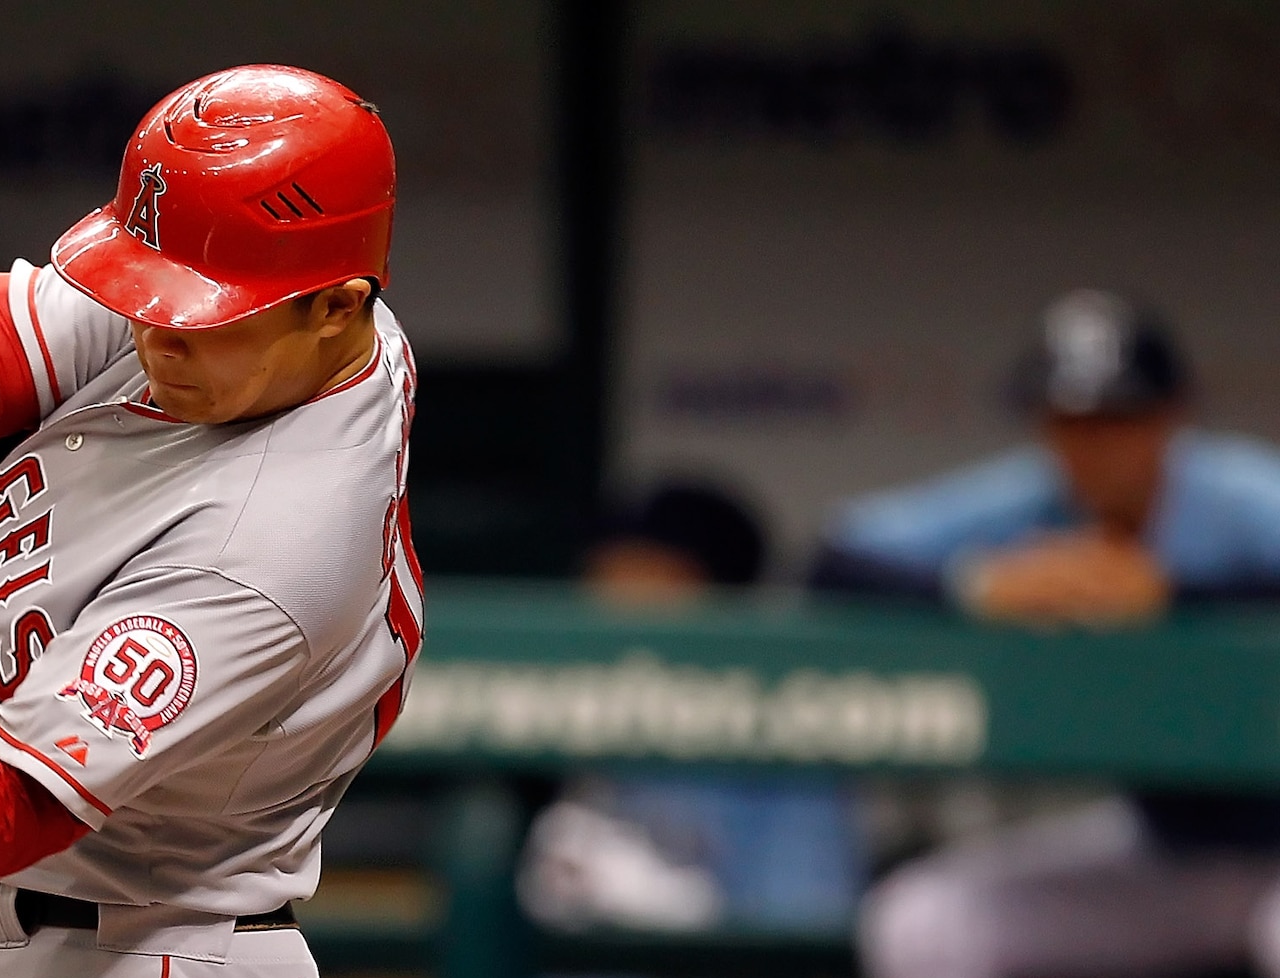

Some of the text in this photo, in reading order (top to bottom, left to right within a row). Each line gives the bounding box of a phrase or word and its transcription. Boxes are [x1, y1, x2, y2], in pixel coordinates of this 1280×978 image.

[124, 161, 167, 251] A
[85, 630, 114, 668] ANGELS
[112, 616, 165, 640] BASEBALL
[160, 657, 196, 724] ANNIVERSARY
[103, 636, 176, 708] 50
